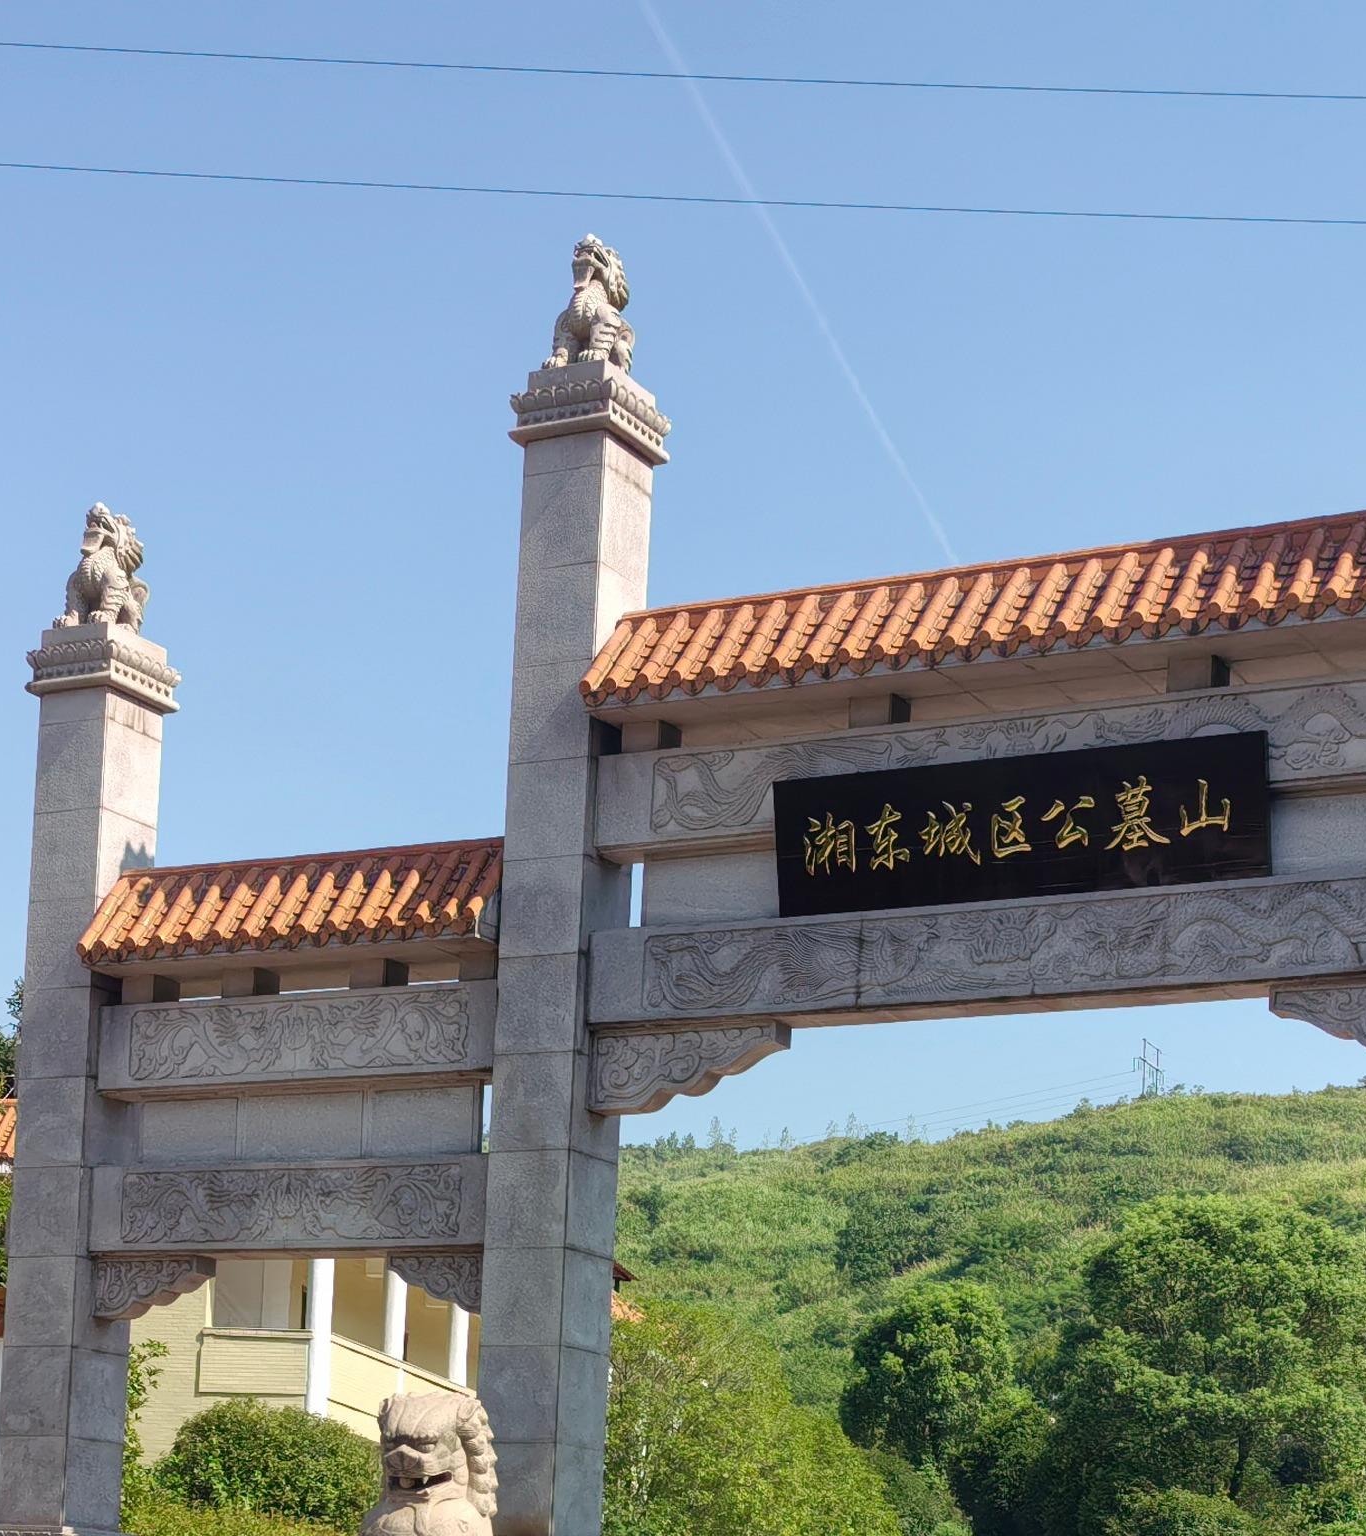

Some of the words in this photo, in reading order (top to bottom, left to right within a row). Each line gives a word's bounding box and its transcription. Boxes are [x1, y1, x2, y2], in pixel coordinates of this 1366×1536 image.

[804, 776, 1231, 876] 湘东城区公墓山
